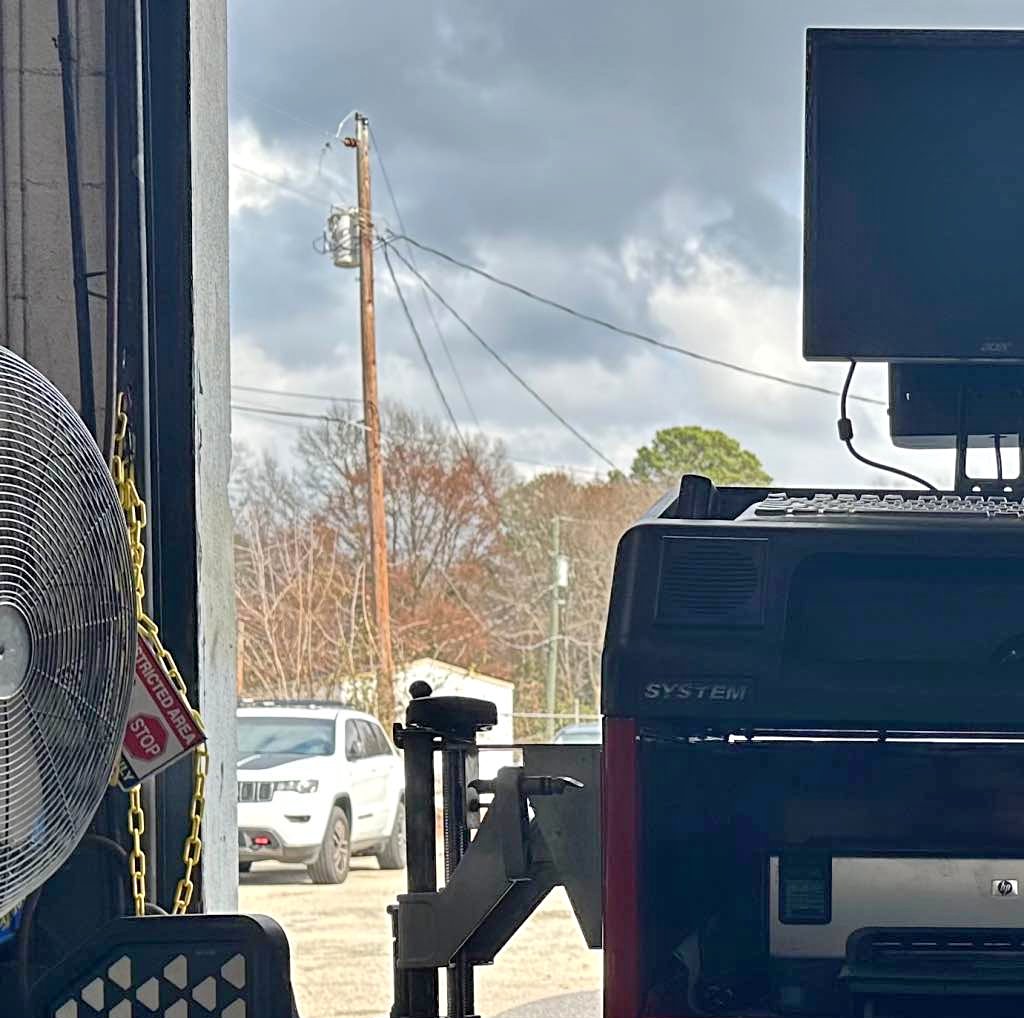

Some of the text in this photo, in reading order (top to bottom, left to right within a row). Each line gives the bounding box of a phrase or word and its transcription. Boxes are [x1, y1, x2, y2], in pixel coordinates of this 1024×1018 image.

[644, 683, 748, 701] SYSTEM
[130, 717, 161, 755] STOP
[167, 708, 197, 746] AREA
